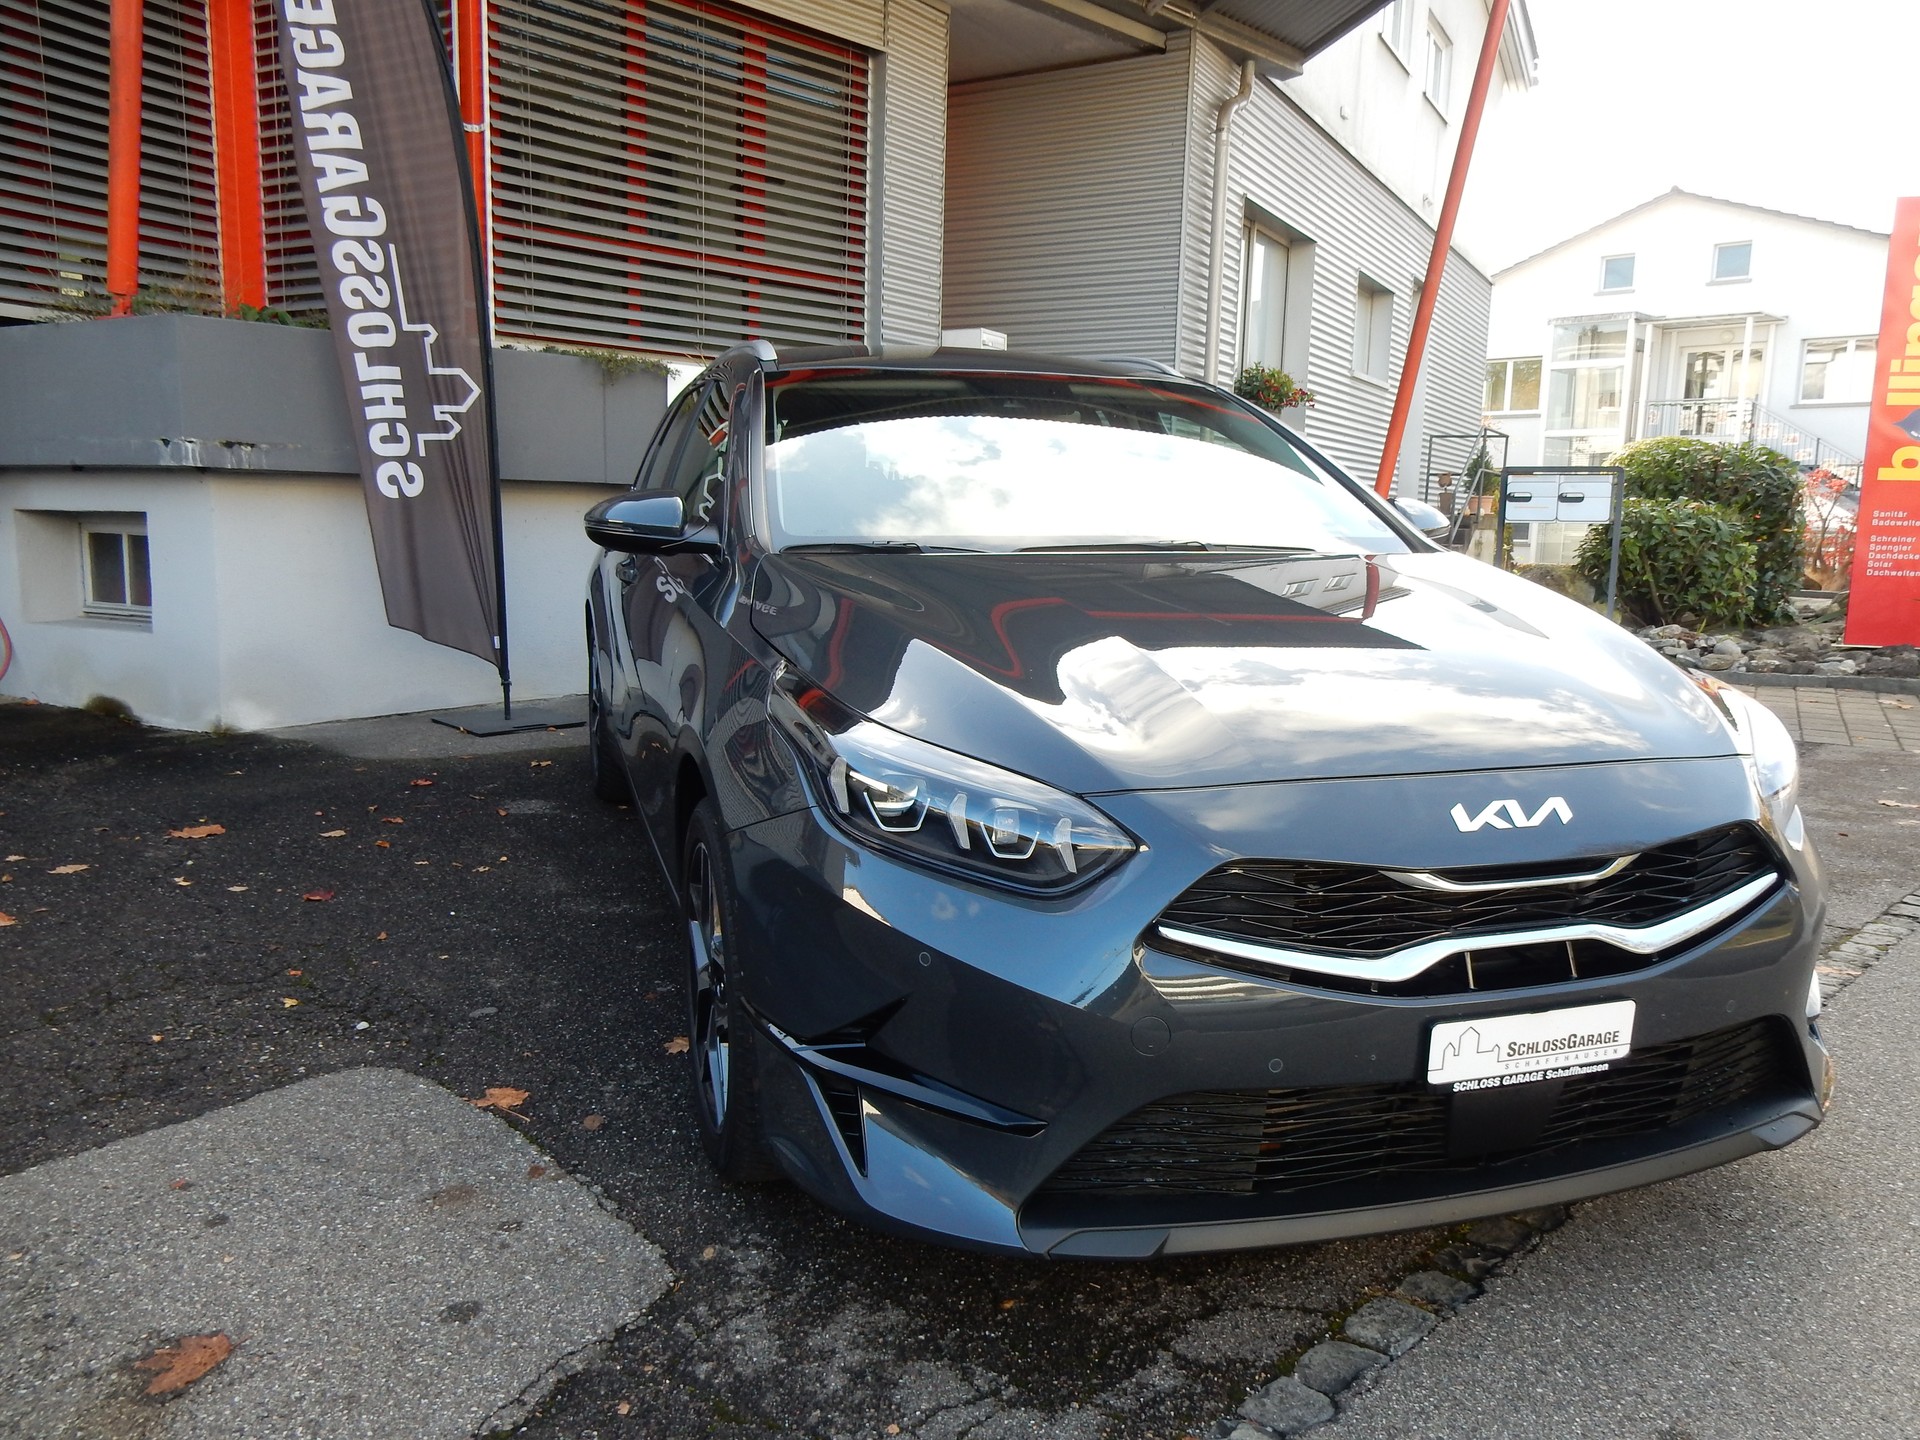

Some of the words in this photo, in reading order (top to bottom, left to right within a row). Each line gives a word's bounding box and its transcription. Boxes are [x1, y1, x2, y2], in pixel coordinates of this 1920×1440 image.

[1870, 535, 1916, 543] Schreiner
[1869, 543, 1912, 553] Spengler
[1867, 560, 1892, 568] Solar
[1866, 569, 1920, 577] Dachwelten
[1450, 796, 1574, 833] KIA
[1504, 1048, 1619, 1071] SCHAFFHAUSEN
[1452, 1077, 1501, 1092] SCHLOSS
[1502, 1070, 1545, 1086] GARAGE
[1545, 1062, 1609, 1079] Schaffhausen
